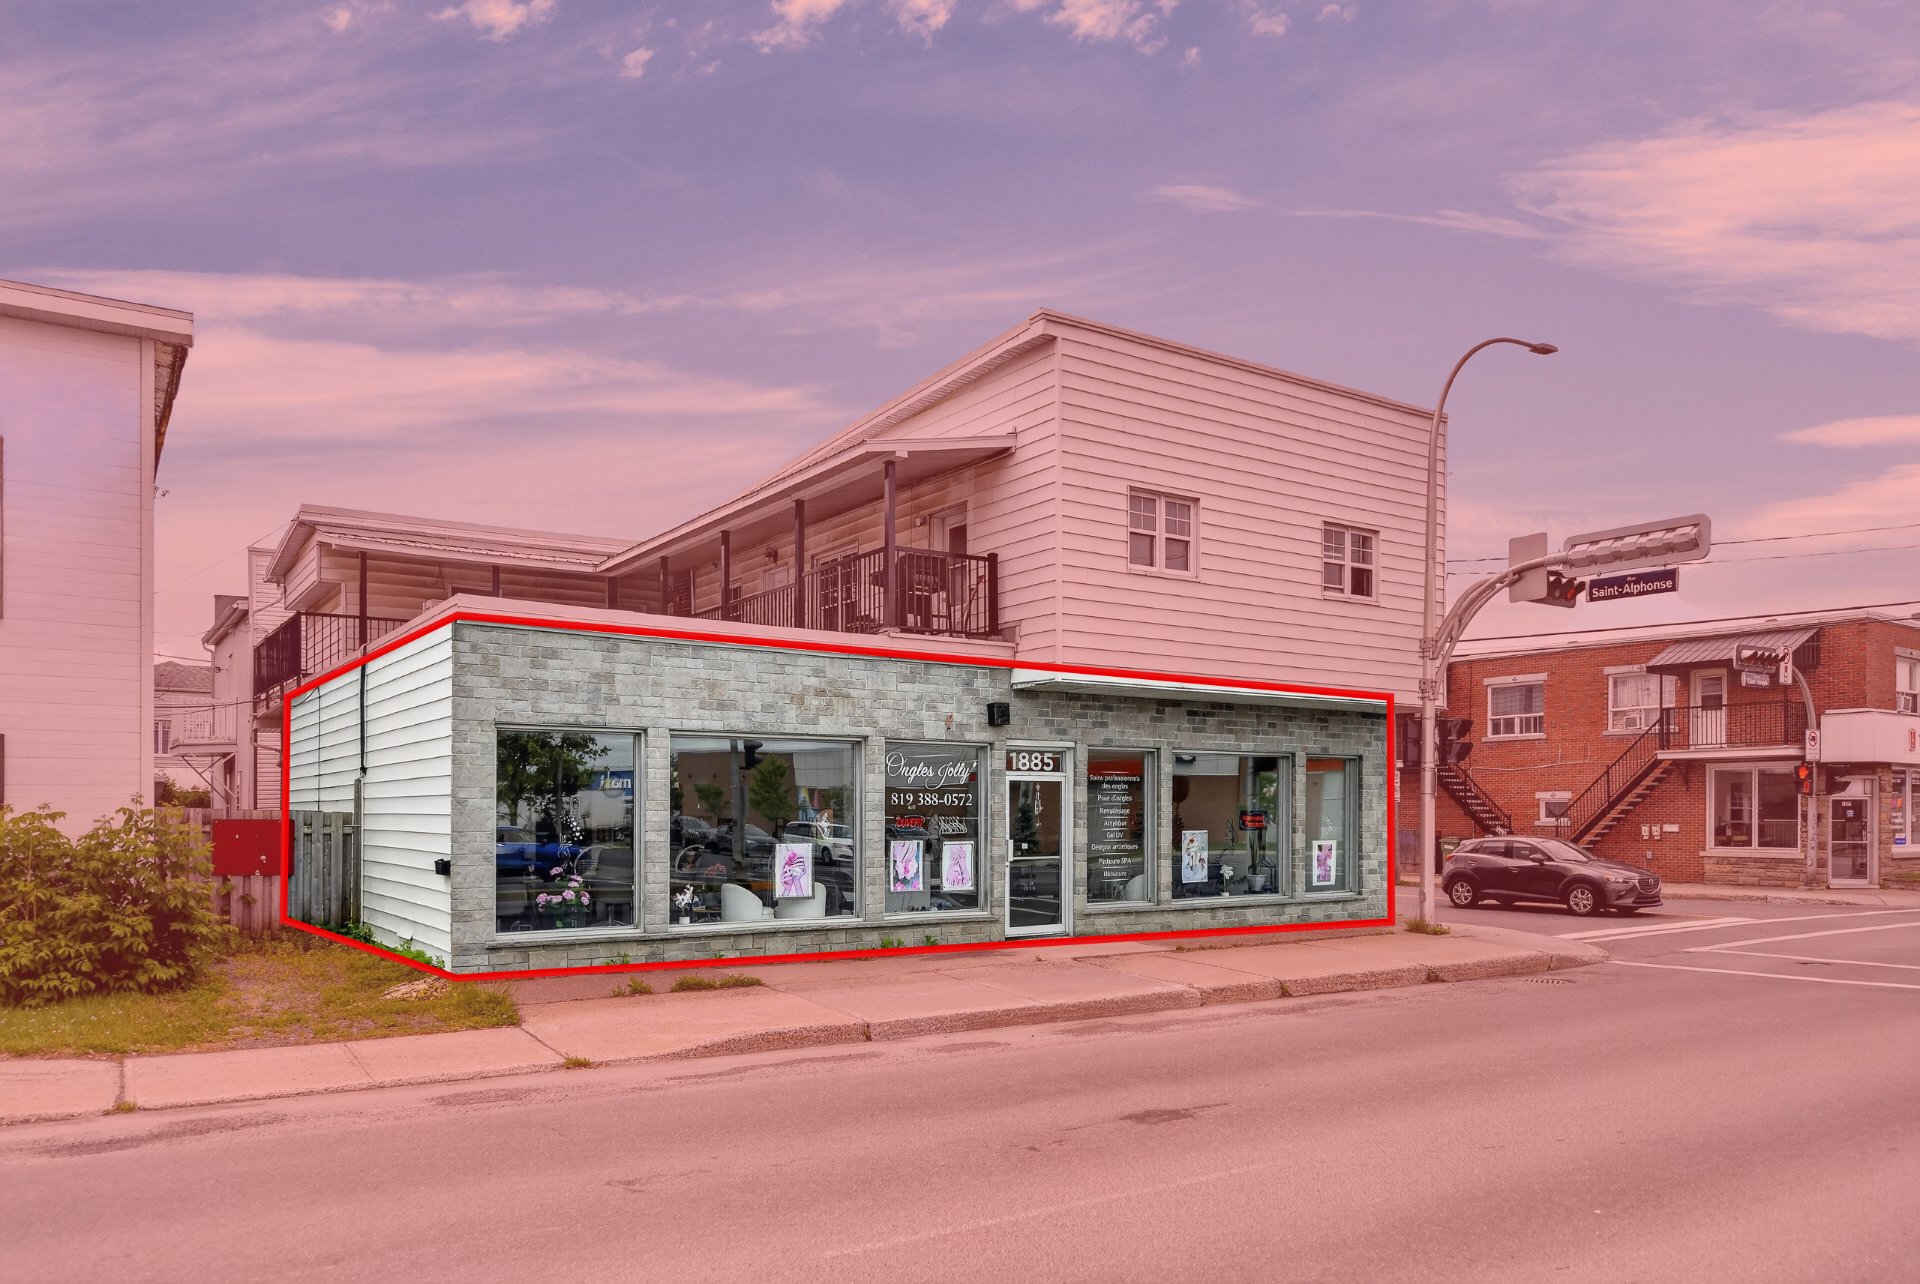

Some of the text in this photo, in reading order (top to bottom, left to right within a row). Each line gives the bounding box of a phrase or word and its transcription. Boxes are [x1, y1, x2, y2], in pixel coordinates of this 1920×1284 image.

[1592, 579, 1673, 597] Saint-Alphonse
[886, 751, 935, 784] Ongles
[1009, 752, 1054, 771] 1885
[891, 792, 973, 806] 819 388-0572
[895, 816, 924, 829] OUVERT
